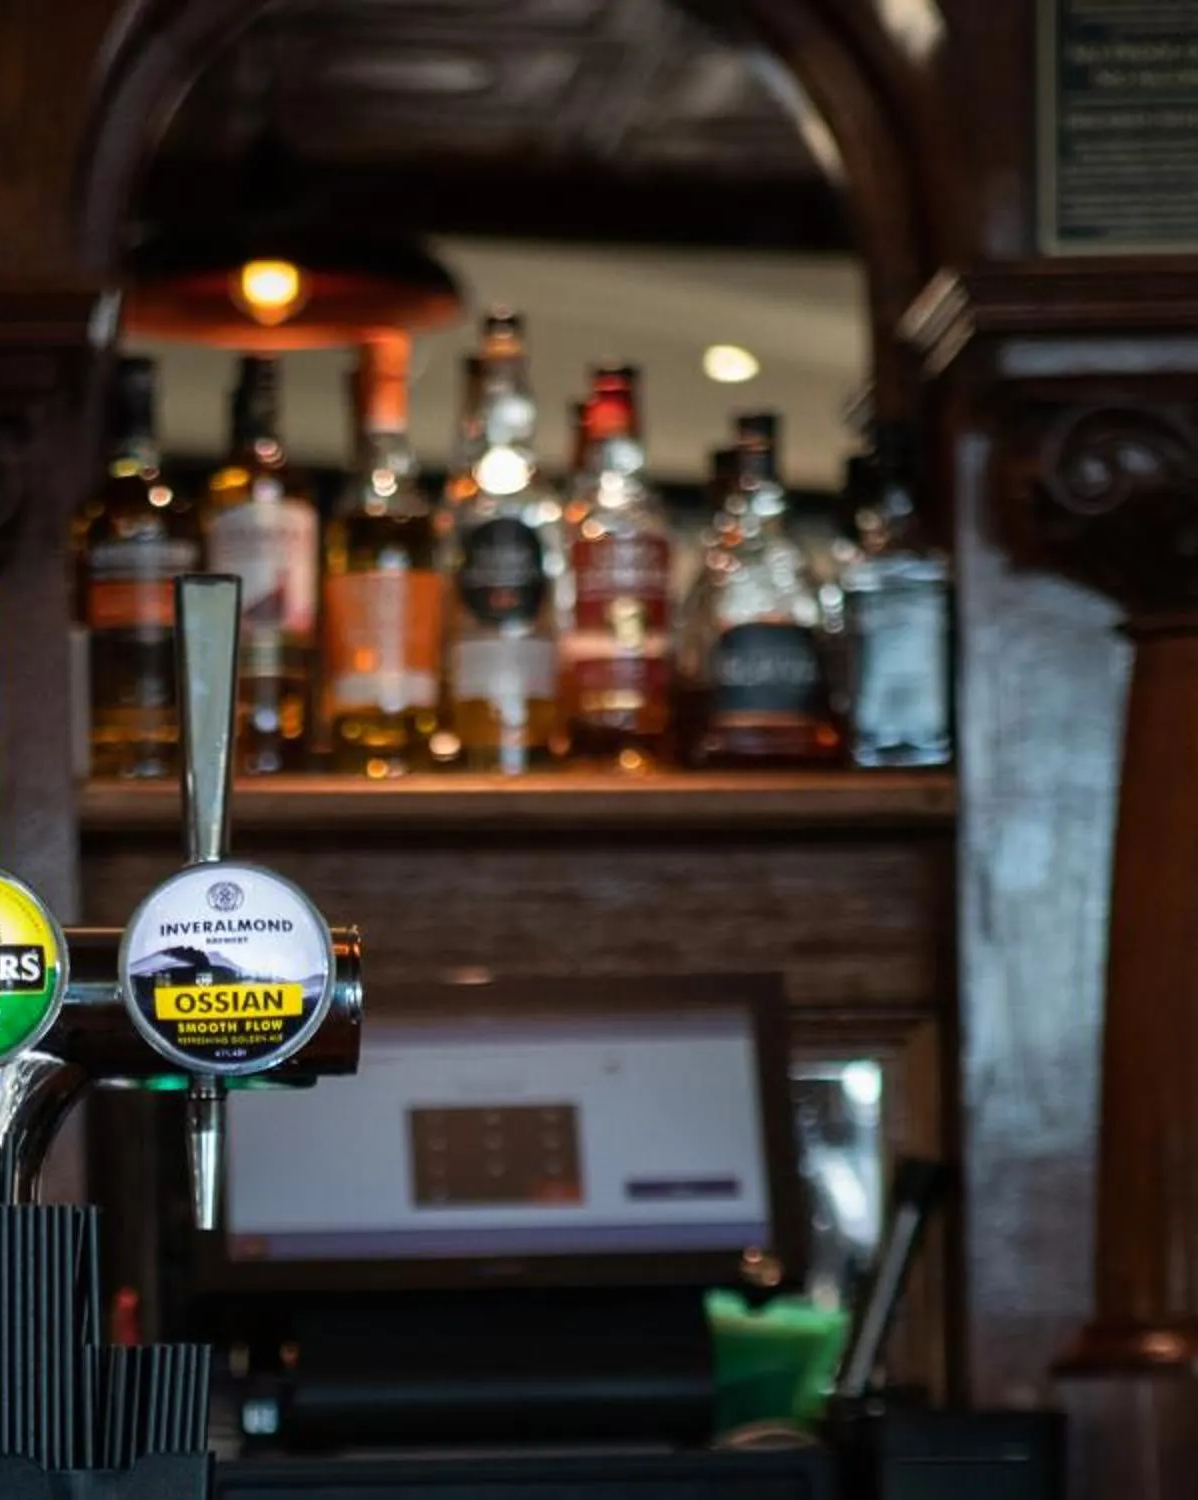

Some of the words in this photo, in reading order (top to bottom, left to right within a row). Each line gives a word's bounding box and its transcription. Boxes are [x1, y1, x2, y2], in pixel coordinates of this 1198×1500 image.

[160, 918, 293, 937] INVERALMOND
[174, 988, 284, 1014] OSSIAN
[177, 1021, 238, 1034] SMOOTH
[245, 1018, 284, 1032] FLOW
